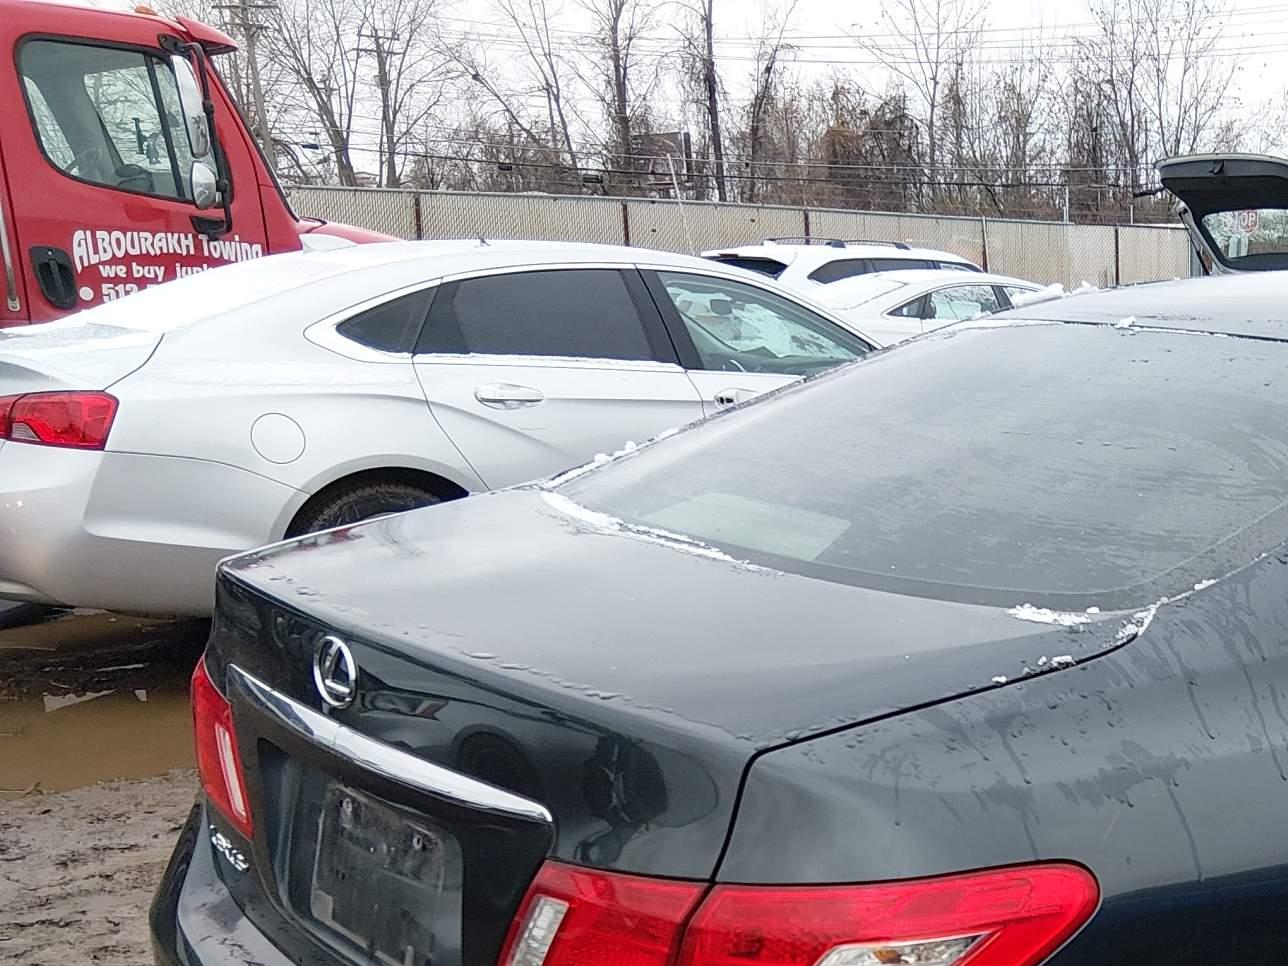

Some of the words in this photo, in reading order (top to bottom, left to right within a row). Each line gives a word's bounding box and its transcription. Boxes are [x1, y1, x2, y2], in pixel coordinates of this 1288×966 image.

[73, 230, 195, 274] ALBOURAKH
[99, 265, 127, 278] we
[132, 262, 165, 282] buy
